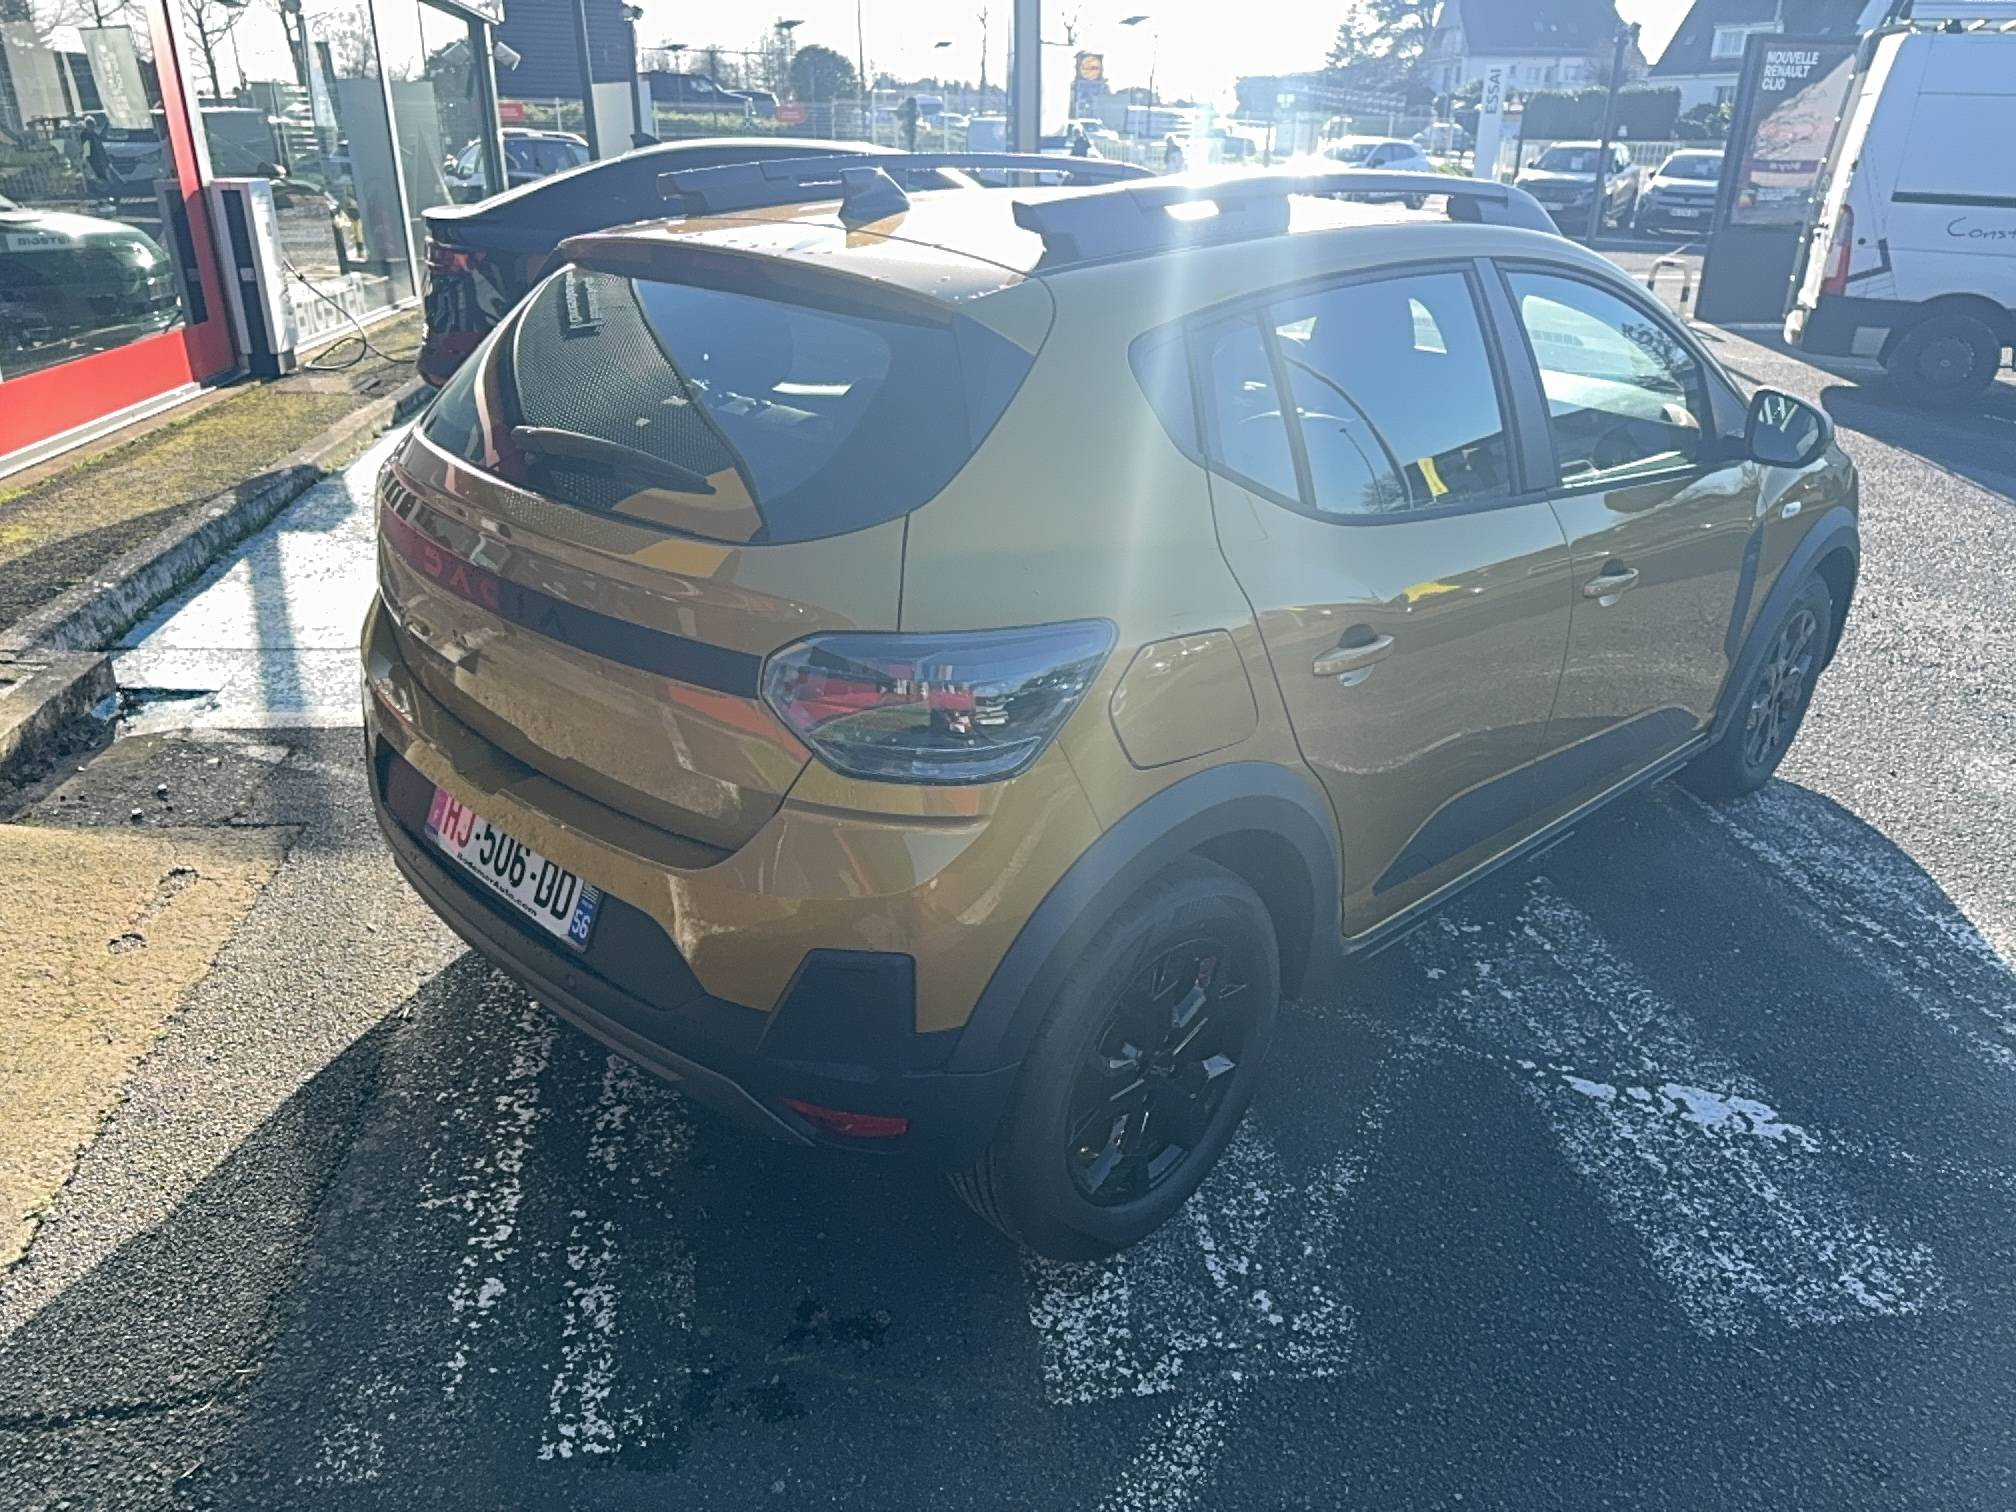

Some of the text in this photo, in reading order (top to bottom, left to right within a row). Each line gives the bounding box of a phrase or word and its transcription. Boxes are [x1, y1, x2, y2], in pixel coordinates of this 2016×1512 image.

[1766, 51, 1820, 65] NOUVELLE
[1763, 65, 1811, 78] RENAULT
[1486, 68, 1502, 114] ESSAI
[1762, 78, 1787, 90] CLIO
[423, 547, 562, 632] DACIA
[571, 911, 591, 939] 56
